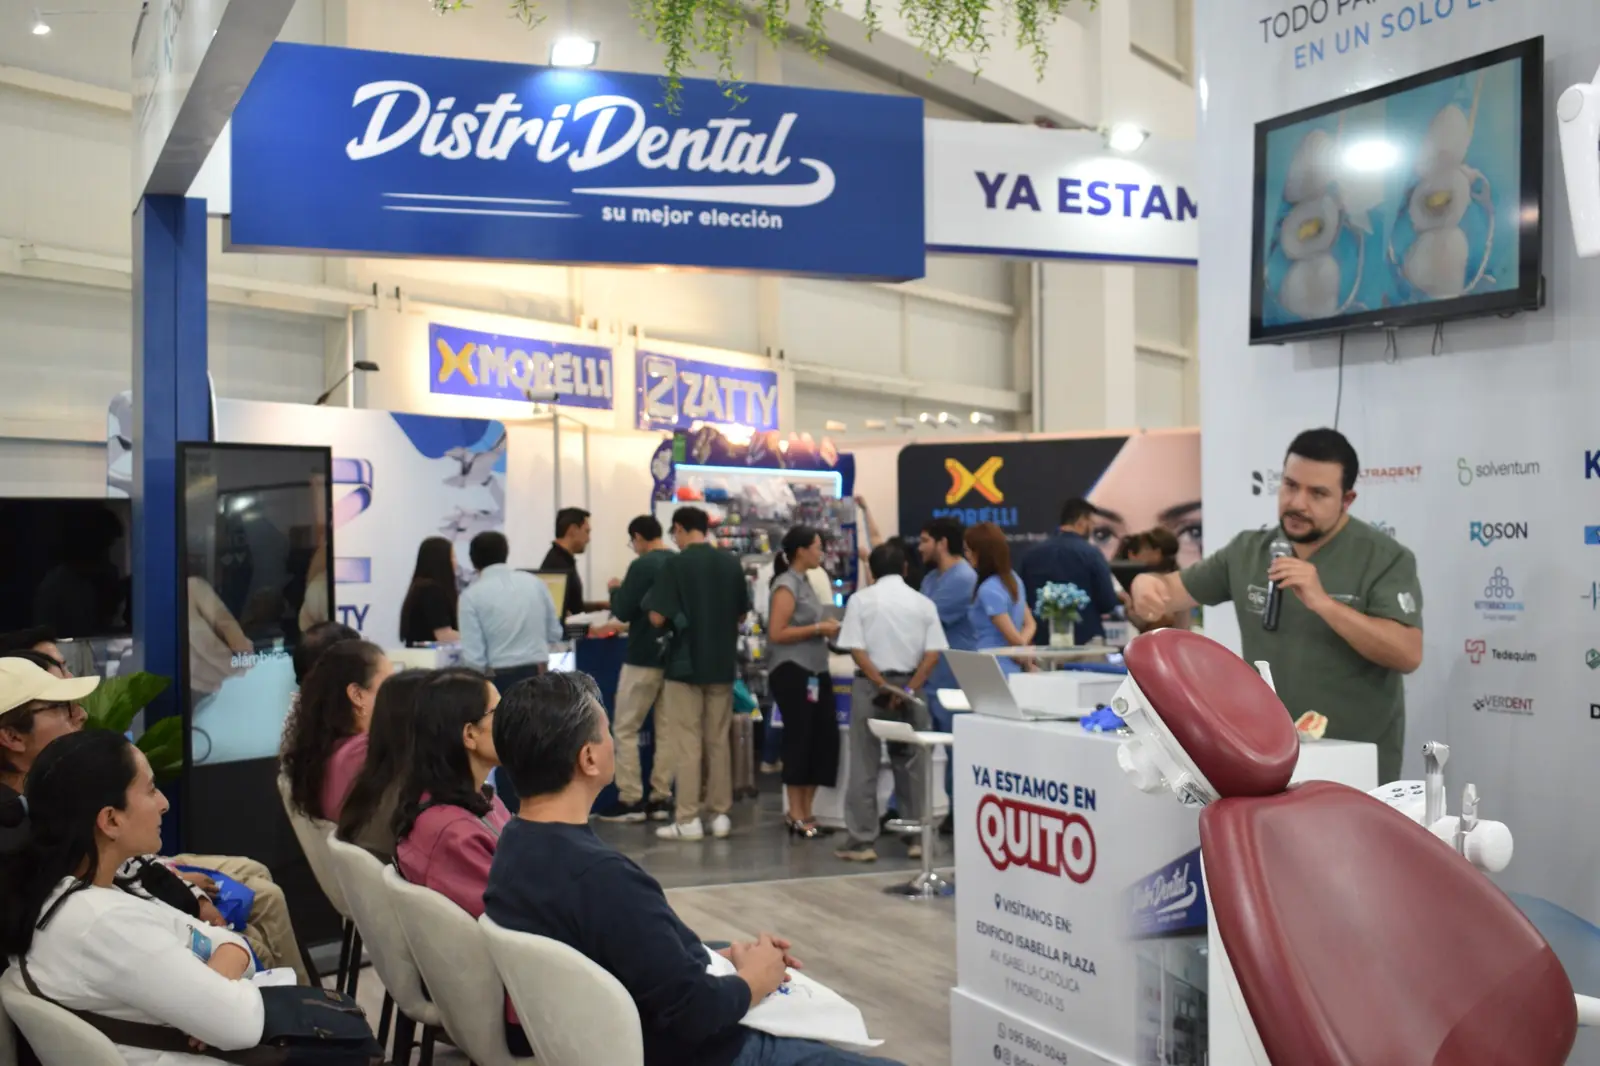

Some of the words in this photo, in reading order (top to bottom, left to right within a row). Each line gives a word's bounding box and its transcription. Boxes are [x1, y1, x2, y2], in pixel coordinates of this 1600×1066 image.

[1259, 0, 1329, 43] TODO
[1294, 38, 1325, 69] EN
[1335, 21, 1370, 54] UN
[1381, 0, 1455, 38] SOLO
[973, 170, 1041, 213] YA
[602, 205, 627, 223] su
[632, 207, 693, 228] mejor
[699, 207, 784, 231] elección
[476, 343, 612, 400] MORELLI
[681, 369, 778, 426] ZATTY
[1475, 460, 1541, 479] solventum
[1470, 521, 1529, 544] ROSON
[1491, 648, 1537, 663] Tedequim
[971, 764, 992, 788] YA
[996, 770, 1068, 806] ESTAMOS
[1074, 786, 1096, 811] EN
[978, 797, 1096, 882] QUITO
[976, 920, 1013, 945] EDIFICIO
[1015, 934, 1061, 963] ISABELLA
[1062, 951, 1097, 977] PLAZA
